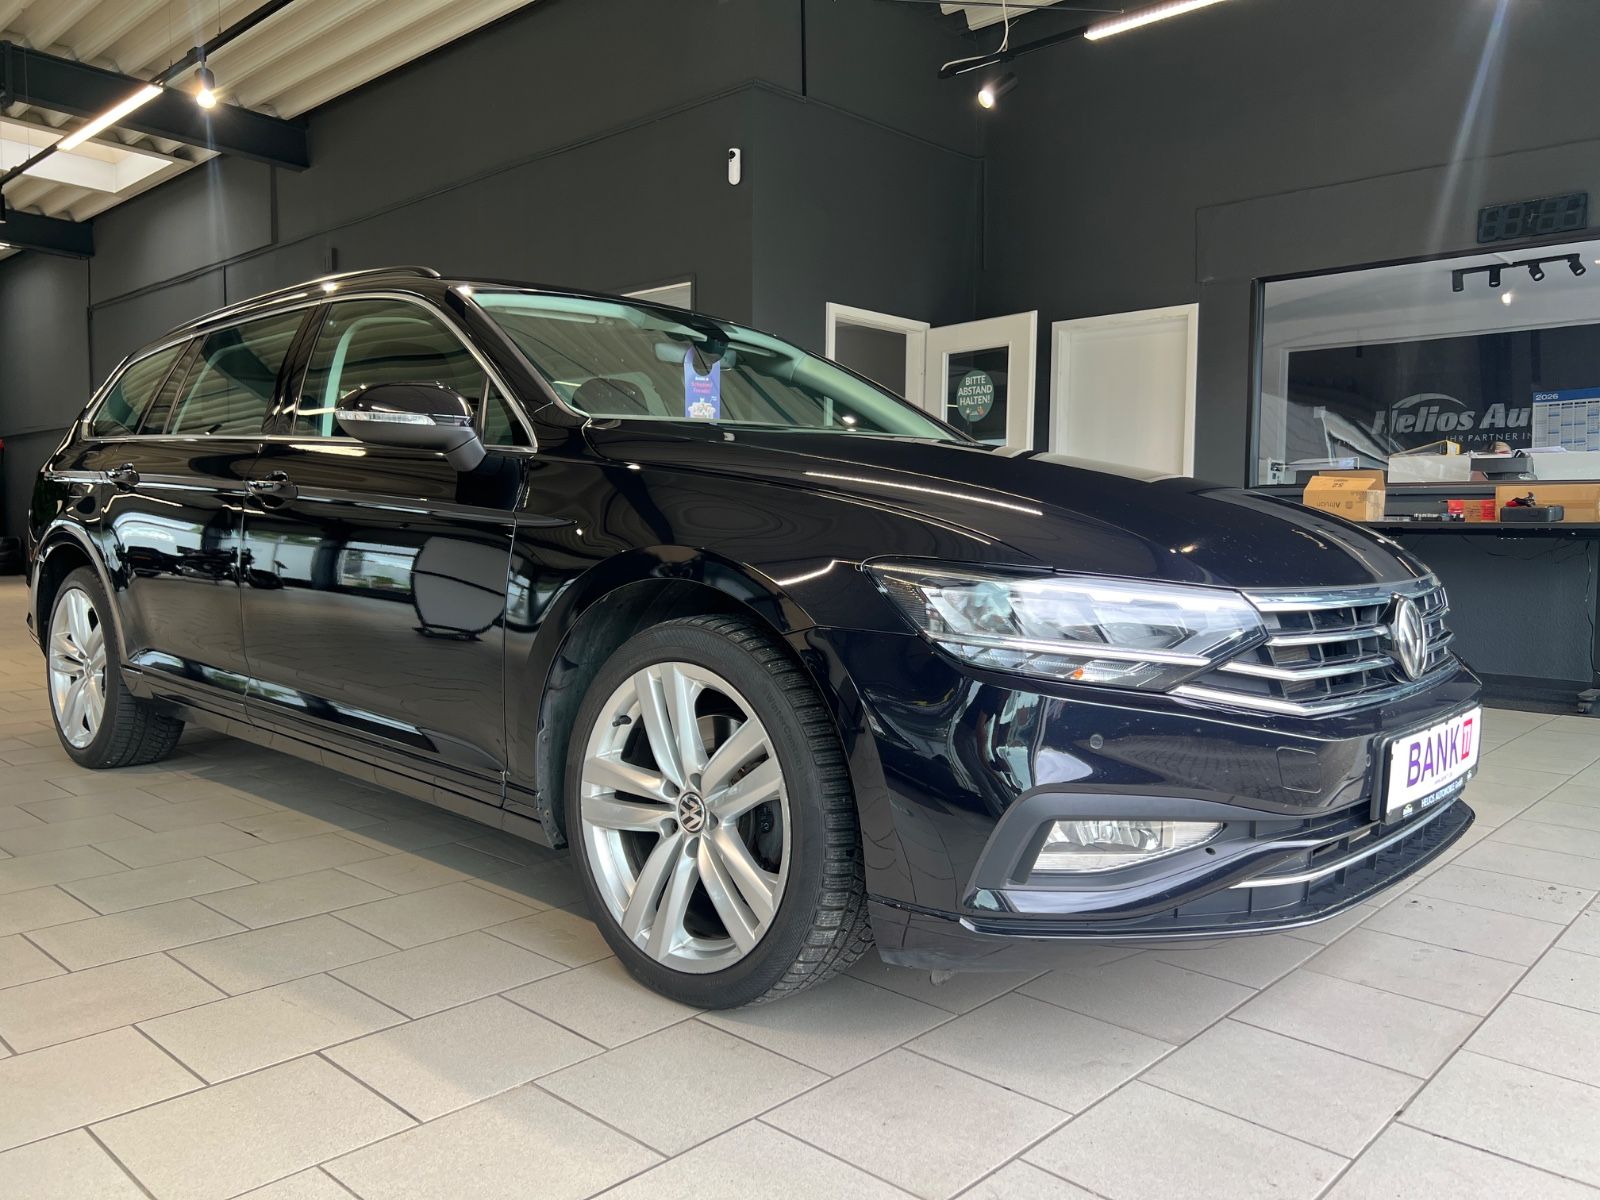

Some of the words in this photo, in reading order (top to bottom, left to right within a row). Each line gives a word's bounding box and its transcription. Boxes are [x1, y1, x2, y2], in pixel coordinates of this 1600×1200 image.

[965, 375, 986, 385] BITTE
[958, 385, 992, 396] ABSTAND
[960, 395, 990, 406] HALTEN!
[1535, 393, 1559, 401] 2026
[1372, 406, 1475, 434] Helios
[1479, 403, 1533, 429] Au
[1445, 434, 1464, 443] IHR
[1467, 432, 1518, 443] PARTNER
[1406, 724, 1460, 788] BANK
